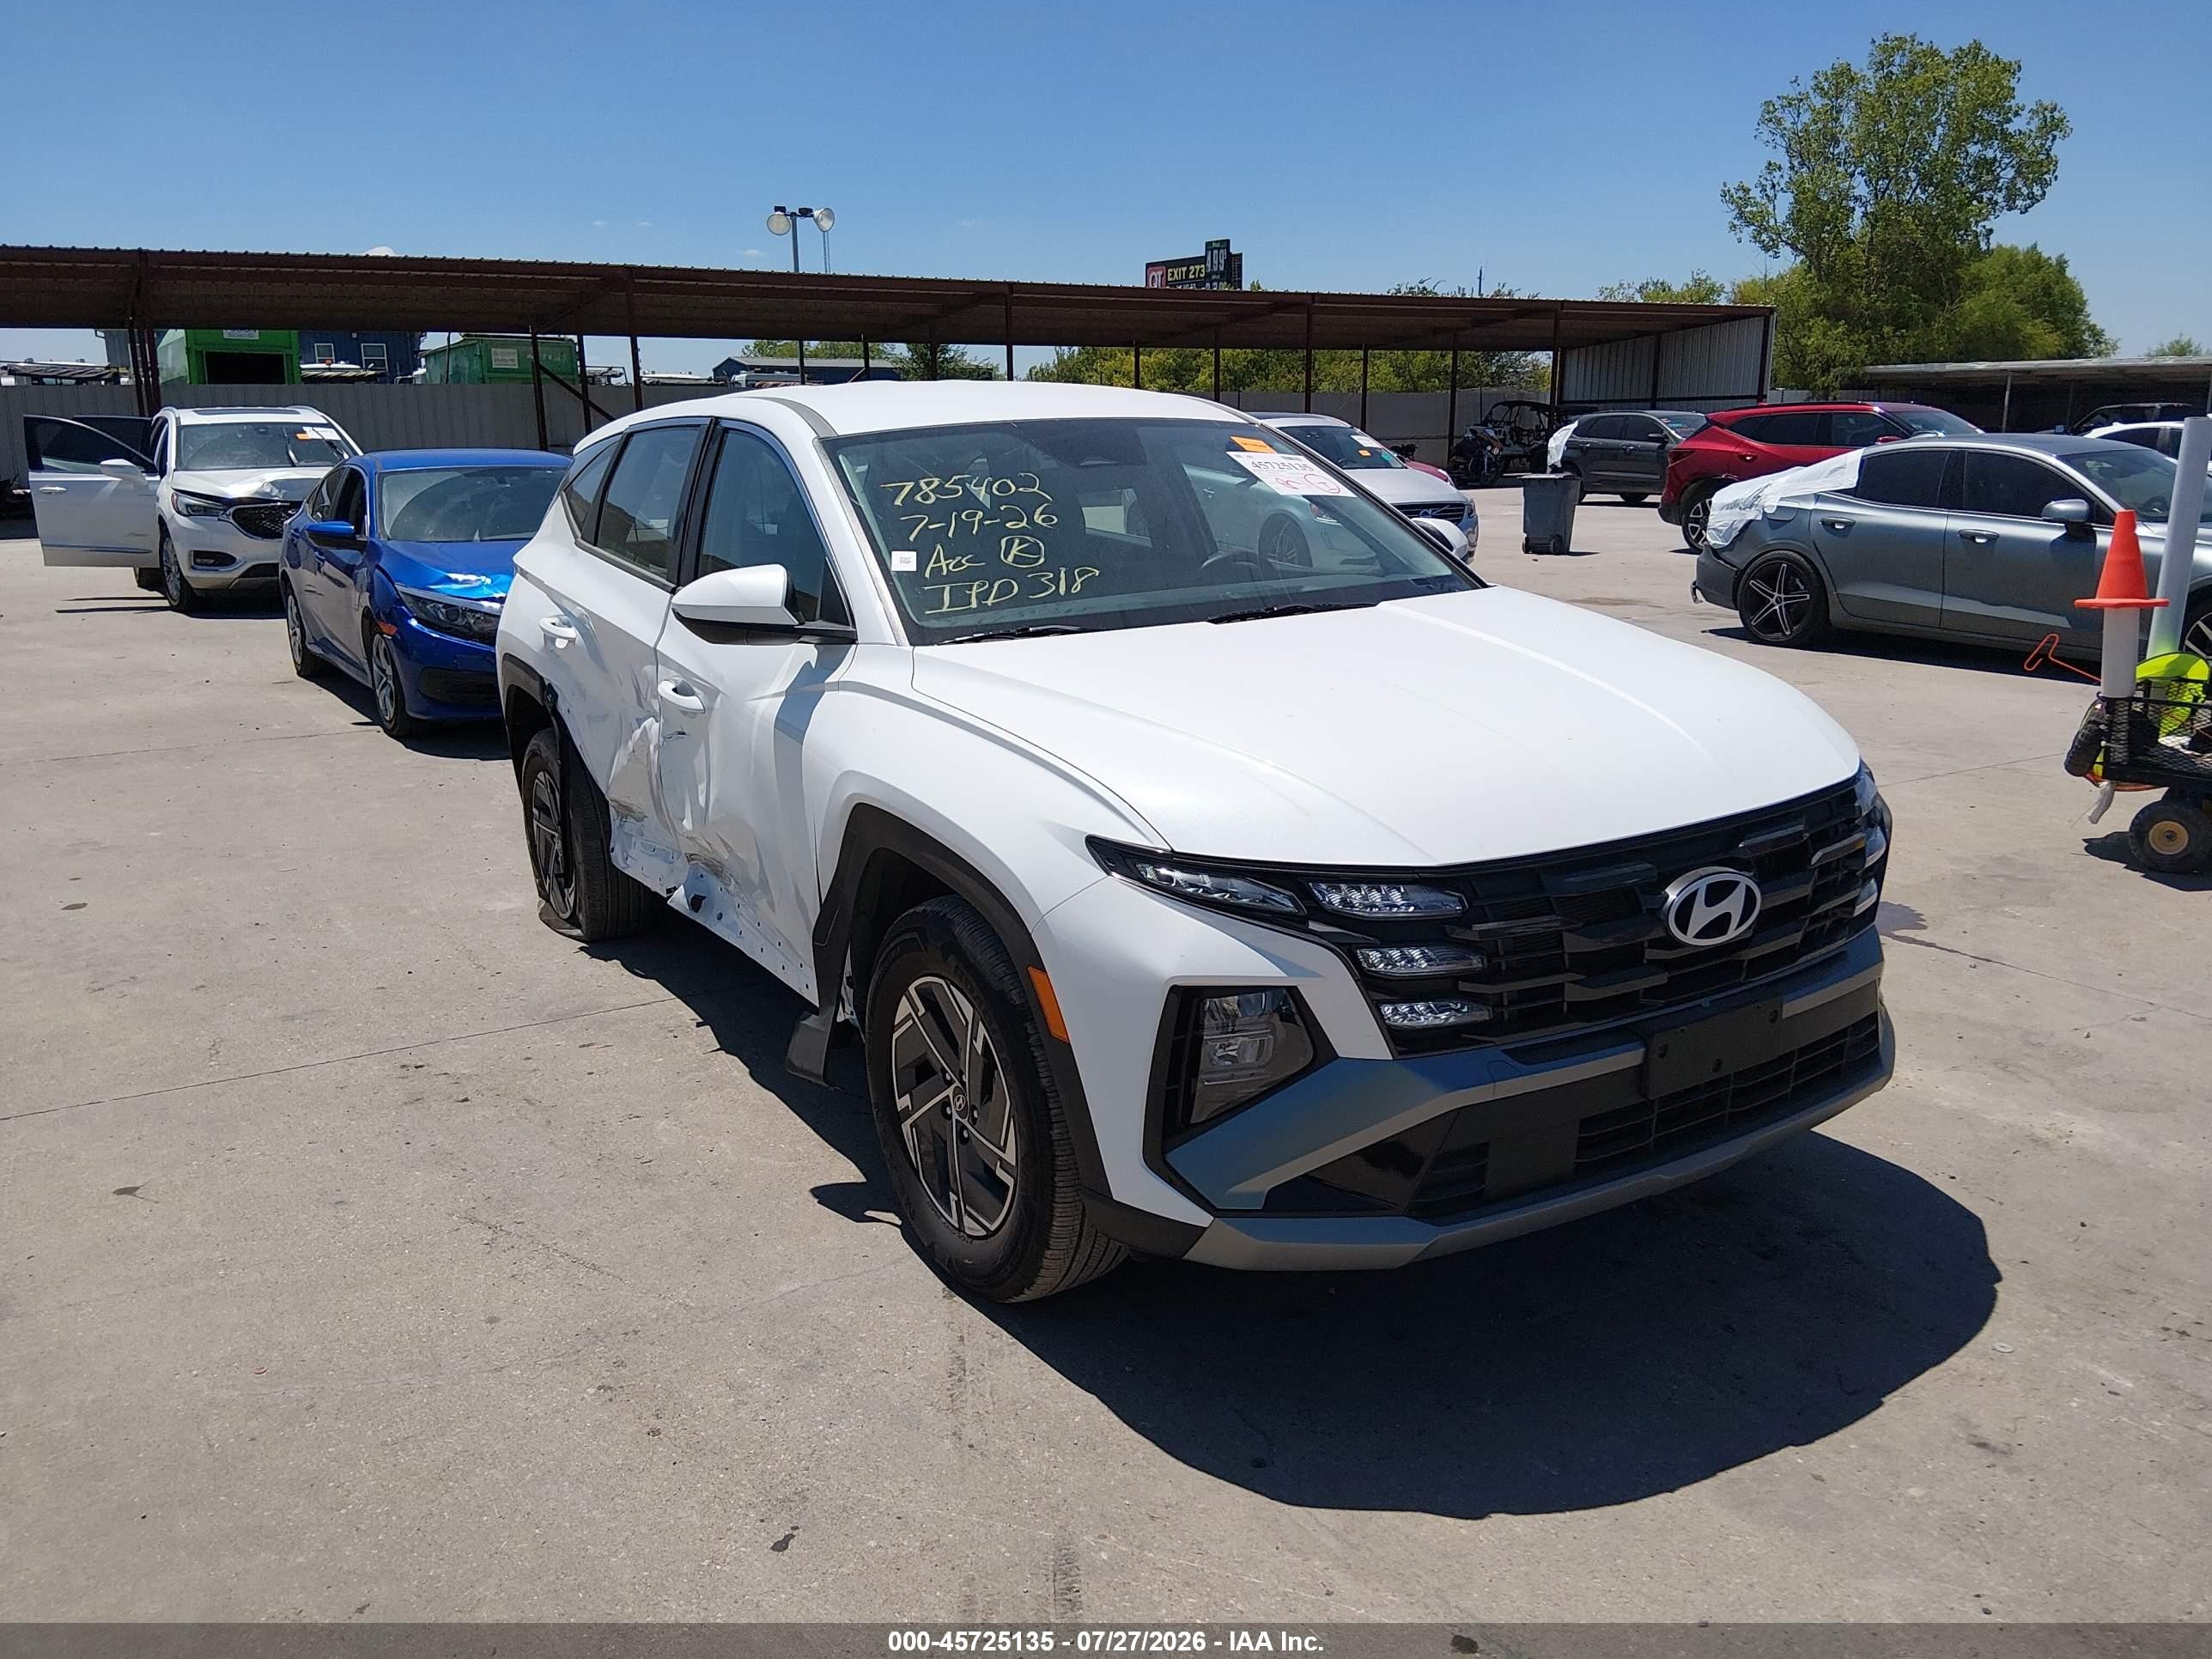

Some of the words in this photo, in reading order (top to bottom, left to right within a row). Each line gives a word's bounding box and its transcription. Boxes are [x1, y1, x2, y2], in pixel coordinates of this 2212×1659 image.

[1167, 266, 1188, 282] EXIT
[1188, 264, 1206, 279] 273
[1251, 461, 1315, 472] 45725135
[879, 472, 1054, 507] 785402
[899, 503, 1059, 542] 7-19-26
[1026, 567, 1101, 599] 318
